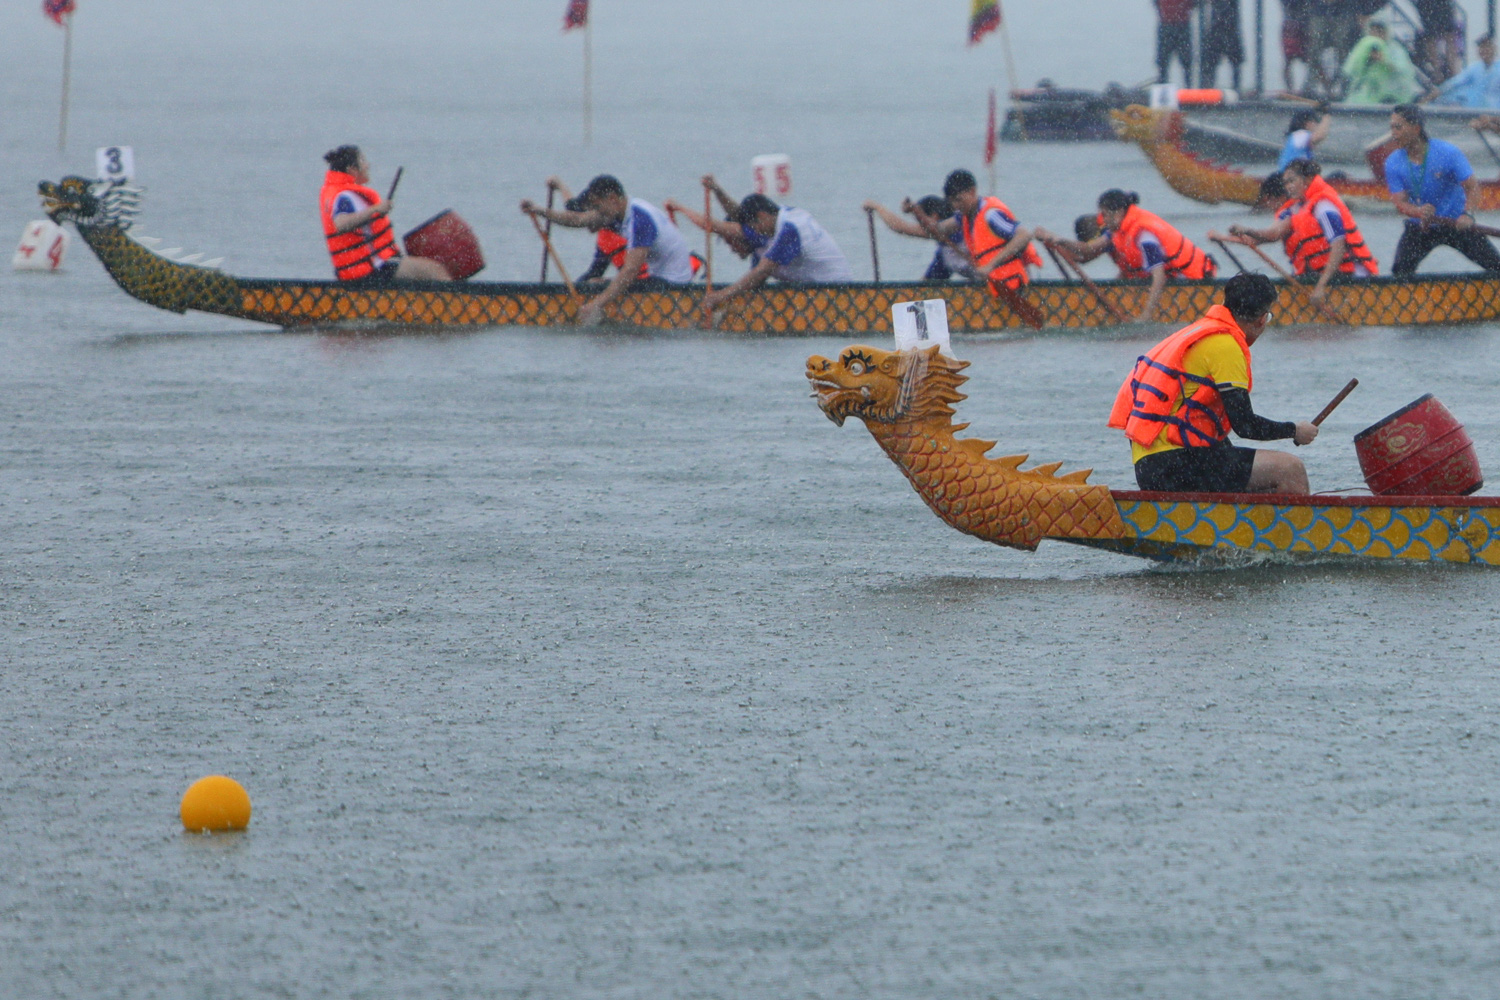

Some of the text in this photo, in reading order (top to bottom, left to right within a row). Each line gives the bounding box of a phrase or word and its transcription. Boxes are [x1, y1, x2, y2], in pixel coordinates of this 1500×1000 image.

[105, 147, 123, 173] 3
[775, 163, 791, 194] 5
[907, 301, 929, 340] 1
